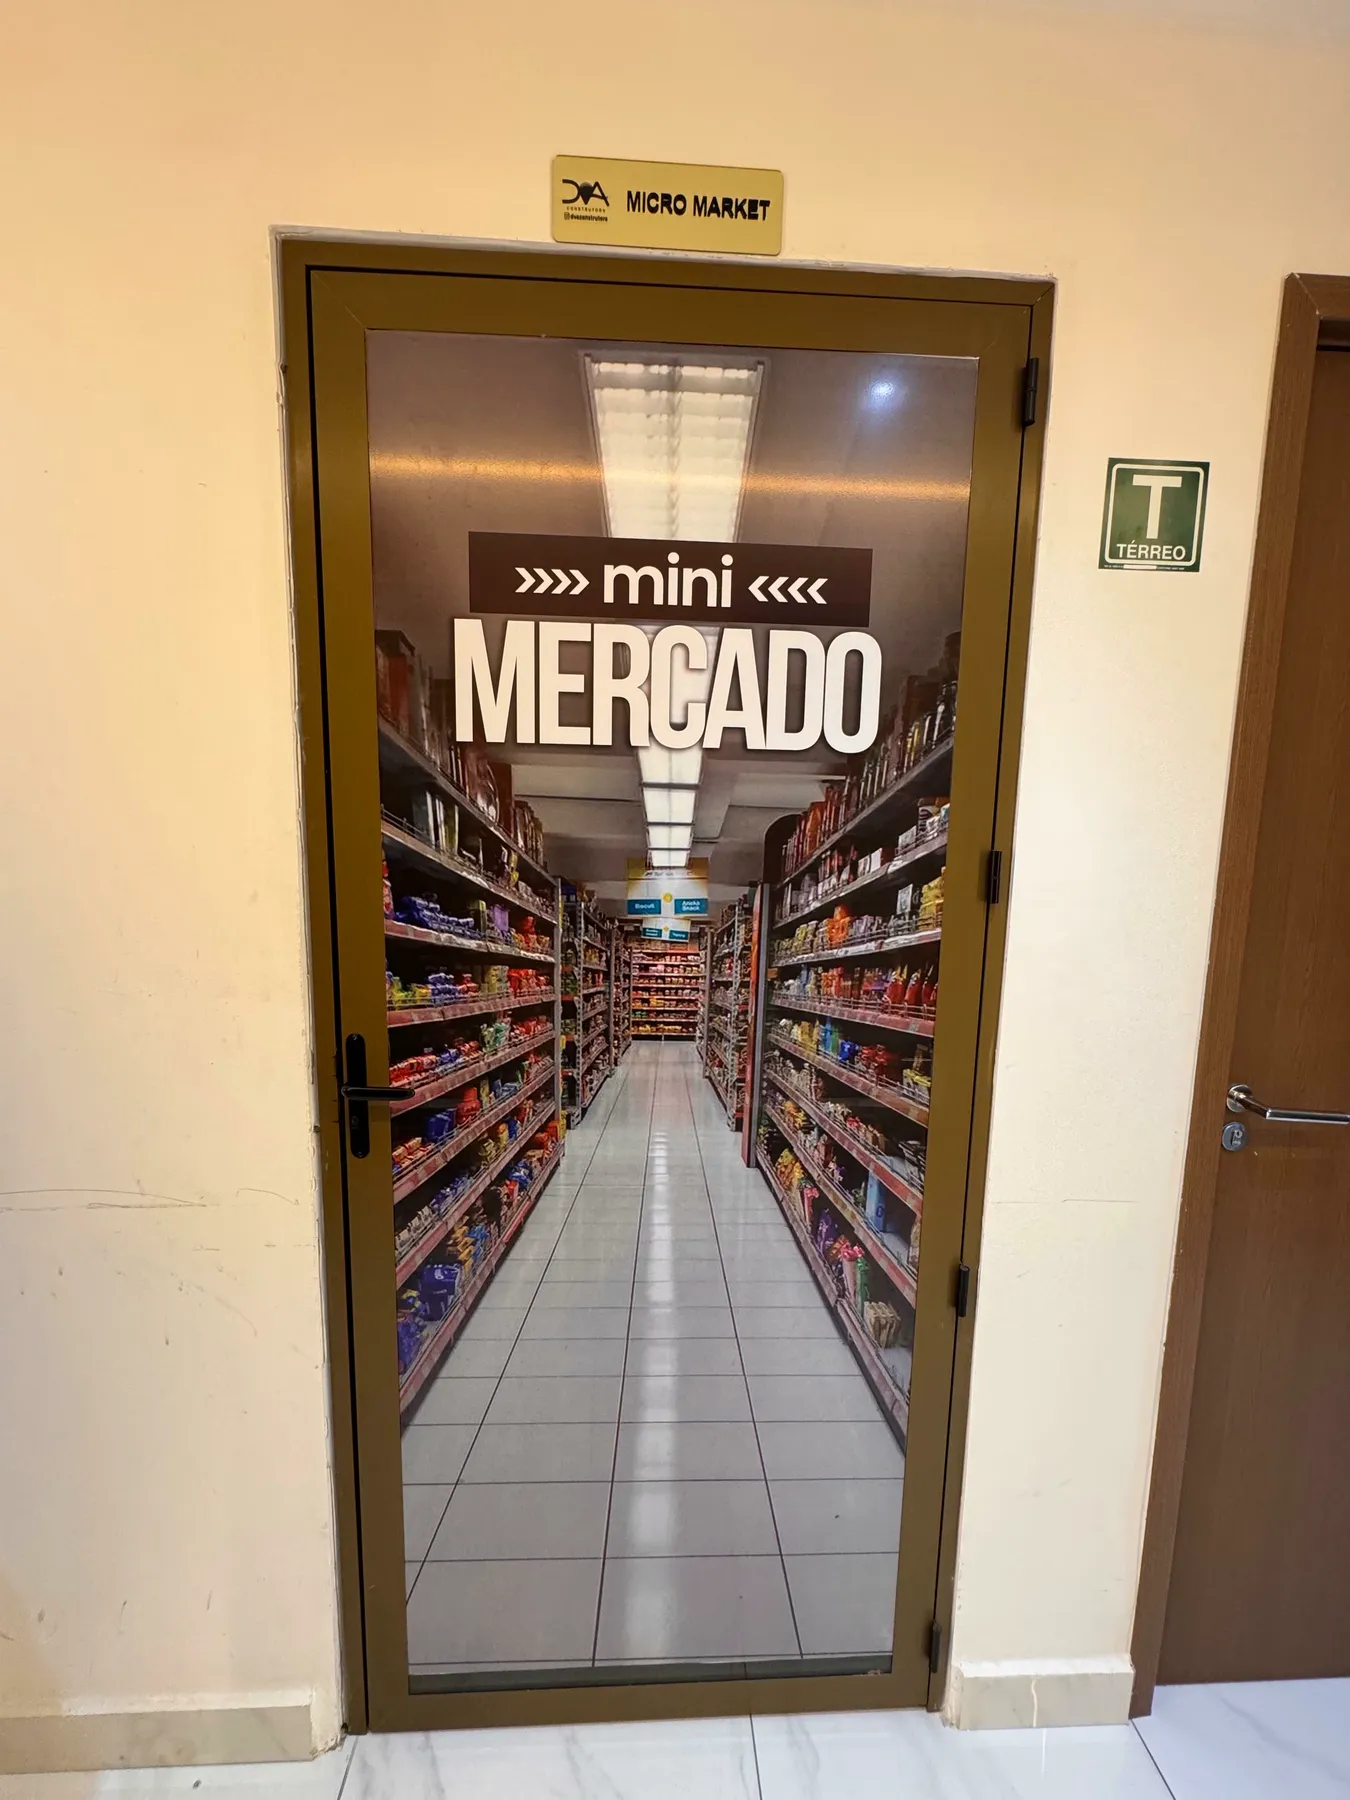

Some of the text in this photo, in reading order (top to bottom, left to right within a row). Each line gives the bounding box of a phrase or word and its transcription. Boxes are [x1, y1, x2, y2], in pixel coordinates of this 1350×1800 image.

[626, 190, 771, 221] MICRO MARKET
[1132, 474, 1182, 539] T
[1116, 540, 1186, 560] TÉRREO
[603, 552, 733, 608] mini
[454, 618, 882, 754] MERCADO
